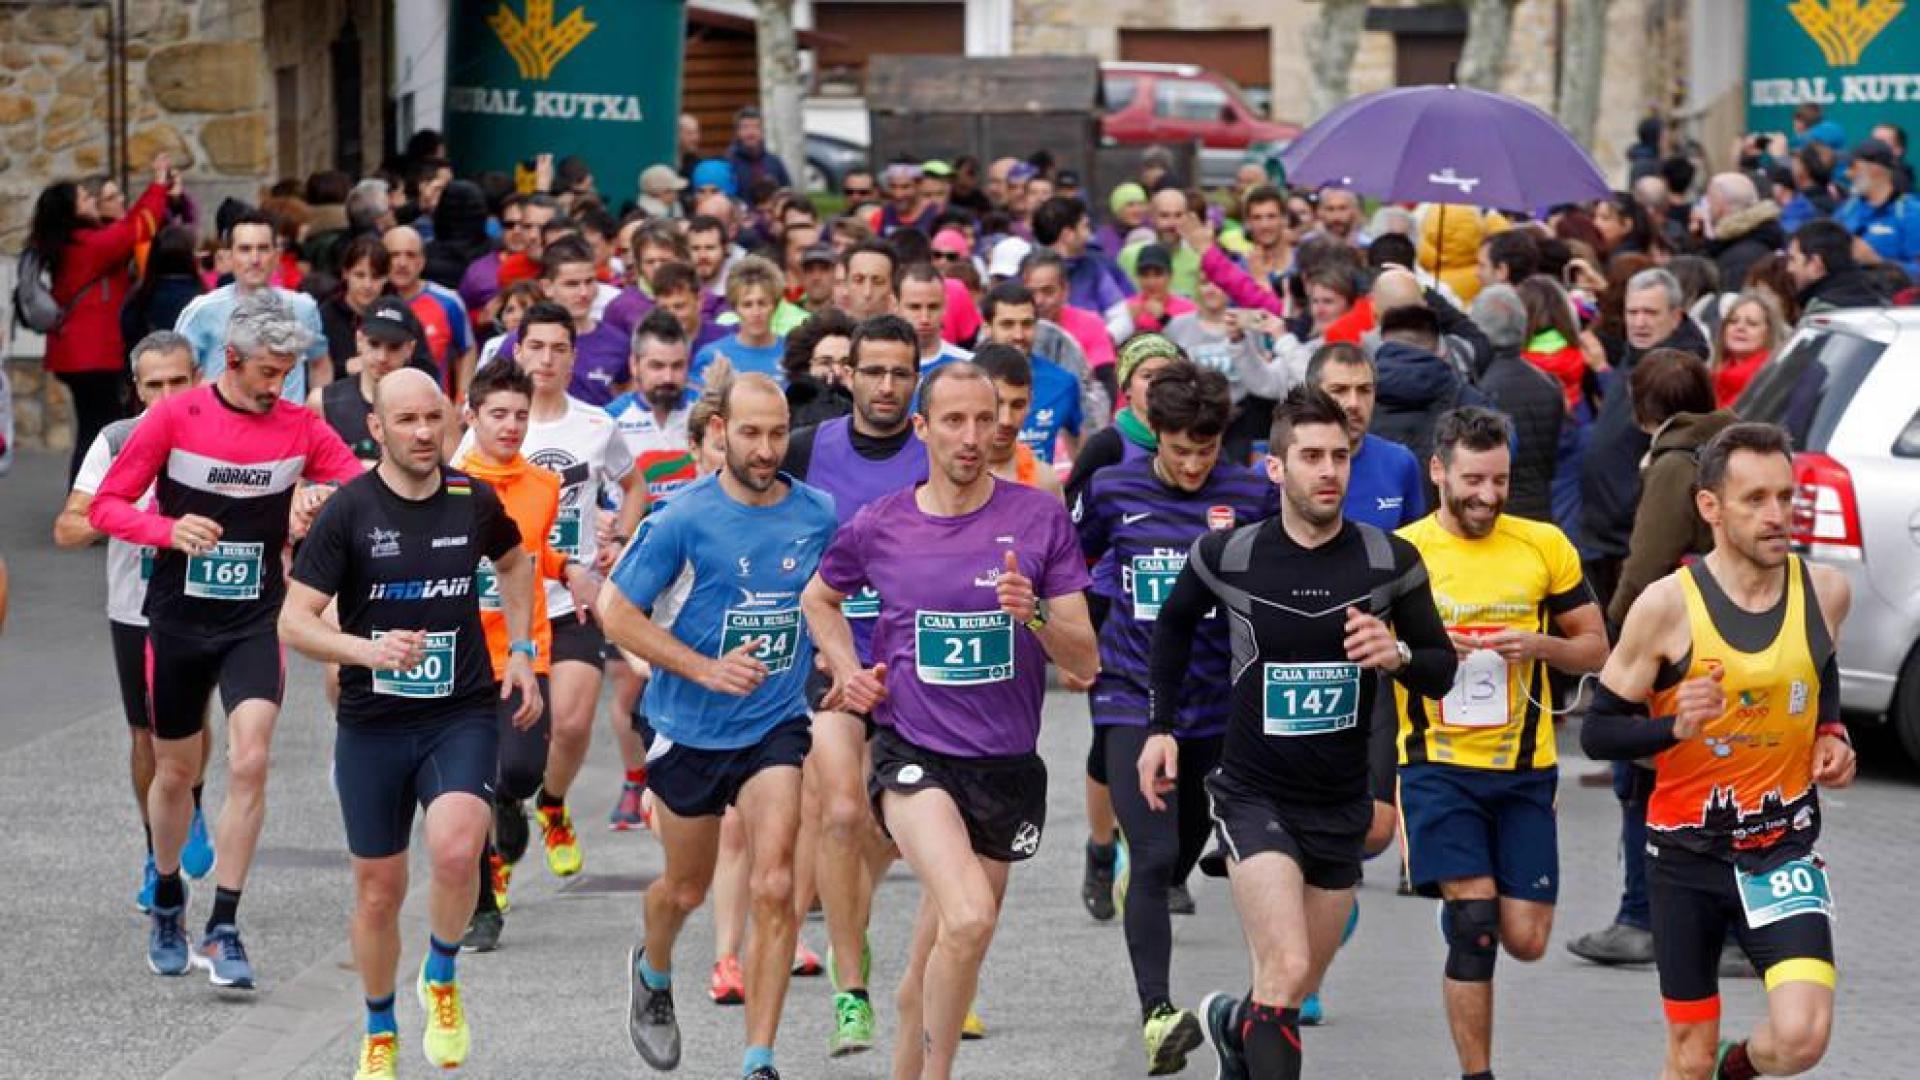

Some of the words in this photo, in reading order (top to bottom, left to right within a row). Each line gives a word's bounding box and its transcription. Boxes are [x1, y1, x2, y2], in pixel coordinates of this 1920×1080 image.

[533, 90, 643, 121] KUTXA
[202, 560, 249, 584] 169
[732, 615, 760, 626] CAJA
[763, 613, 796, 625] RURAL
[924, 616, 955, 628] CAJA
[960, 615, 1006, 628] RURAL
[943, 637, 982, 664] 21
[1271, 669, 1304, 680] CAJA
[1308, 668, 1352, 680] RURAL
[1283, 688, 1343, 715] 147
[1769, 868, 1814, 898] 80
